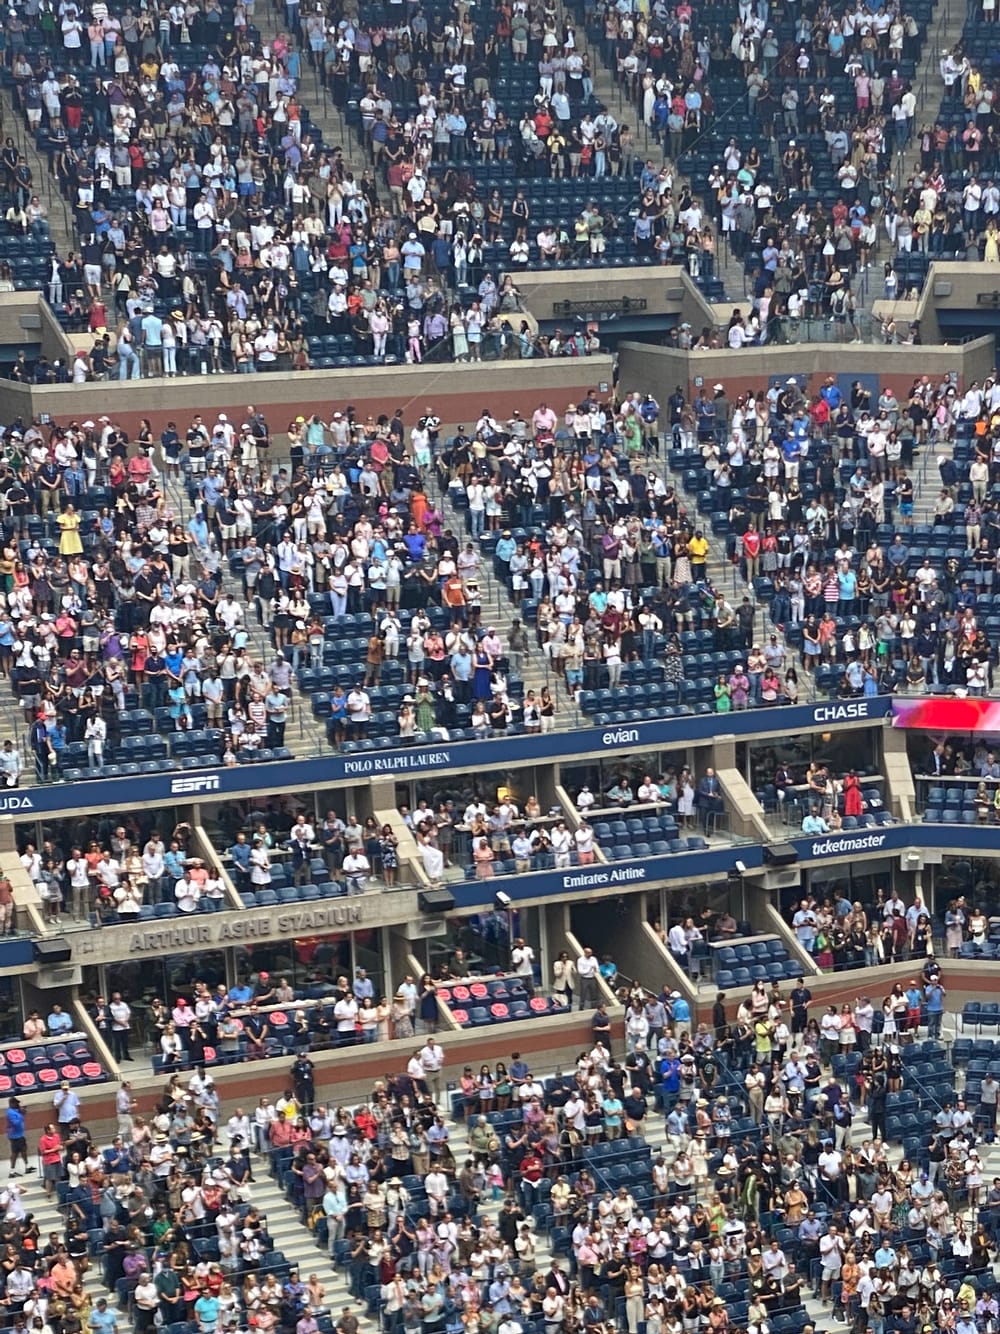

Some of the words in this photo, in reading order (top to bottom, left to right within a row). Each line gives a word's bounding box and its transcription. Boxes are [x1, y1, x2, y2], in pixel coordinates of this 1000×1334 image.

[814, 703, 868, 721] CHASE
[602, 727, 638, 744] evian
[344, 759, 372, 773] POLO
[374, 756, 408, 770] RALPH
[410, 751, 451, 766] LAUREN
[171, 775, 220, 793] ESPN
[811, 834, 886, 855] ticketmaster
[563, 869, 609, 888] Emirates
[609, 865, 646, 882] Airline
[129, 925, 211, 953] ARTHUR
[218, 918, 271, 942] ASHE
[278, 903, 363, 933] STADIUM
